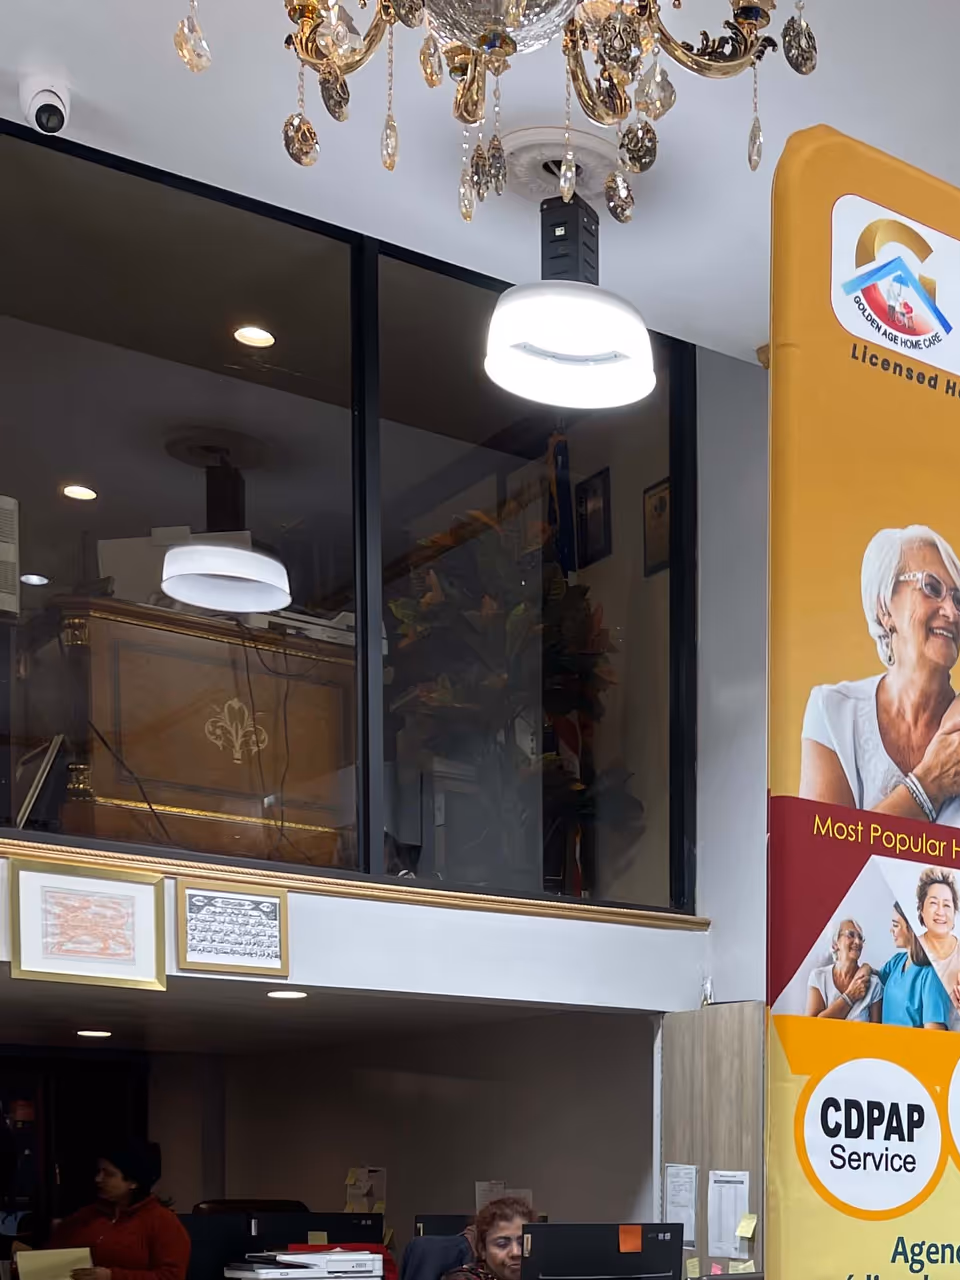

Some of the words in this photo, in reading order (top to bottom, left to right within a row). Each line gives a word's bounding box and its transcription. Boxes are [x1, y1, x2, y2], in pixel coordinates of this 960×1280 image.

[853, 295, 883, 335] GOLDEN
[882, 324, 900, 345] AGE
[900, 338, 922, 350] HOME
[922, 332, 943, 350] CARE
[851, 344, 938, 390] Licensed
[814, 815, 863, 842] Most
[870, 824, 946, 856] Popular
[820, 1097, 925, 1142] CDPAP
[830, 1144, 916, 1172] Service
